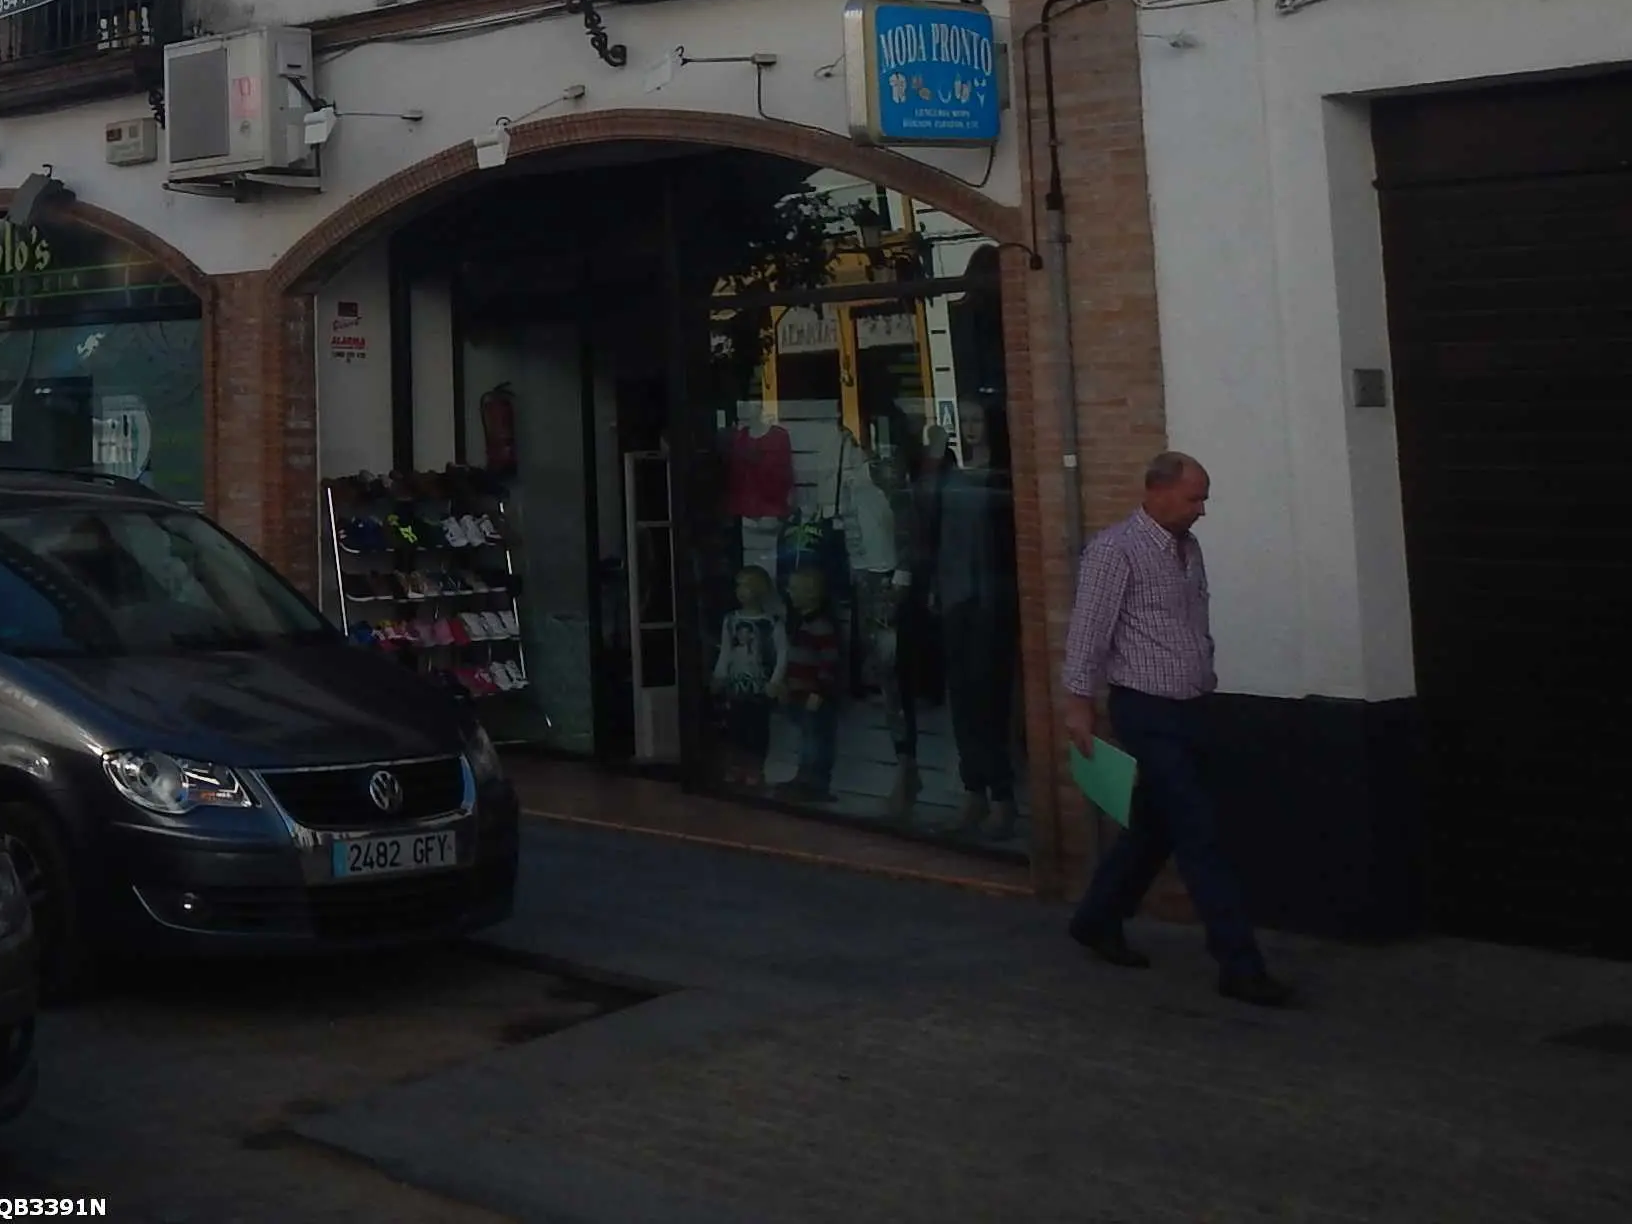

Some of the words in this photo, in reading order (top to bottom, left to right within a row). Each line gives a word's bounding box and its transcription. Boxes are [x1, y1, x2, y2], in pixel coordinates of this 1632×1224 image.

[879, 23, 927, 74] MODA
[930, 22, 993, 76] PRONTO
[349, 840, 402, 871] 2482
[413, 834, 448, 865] GFY
